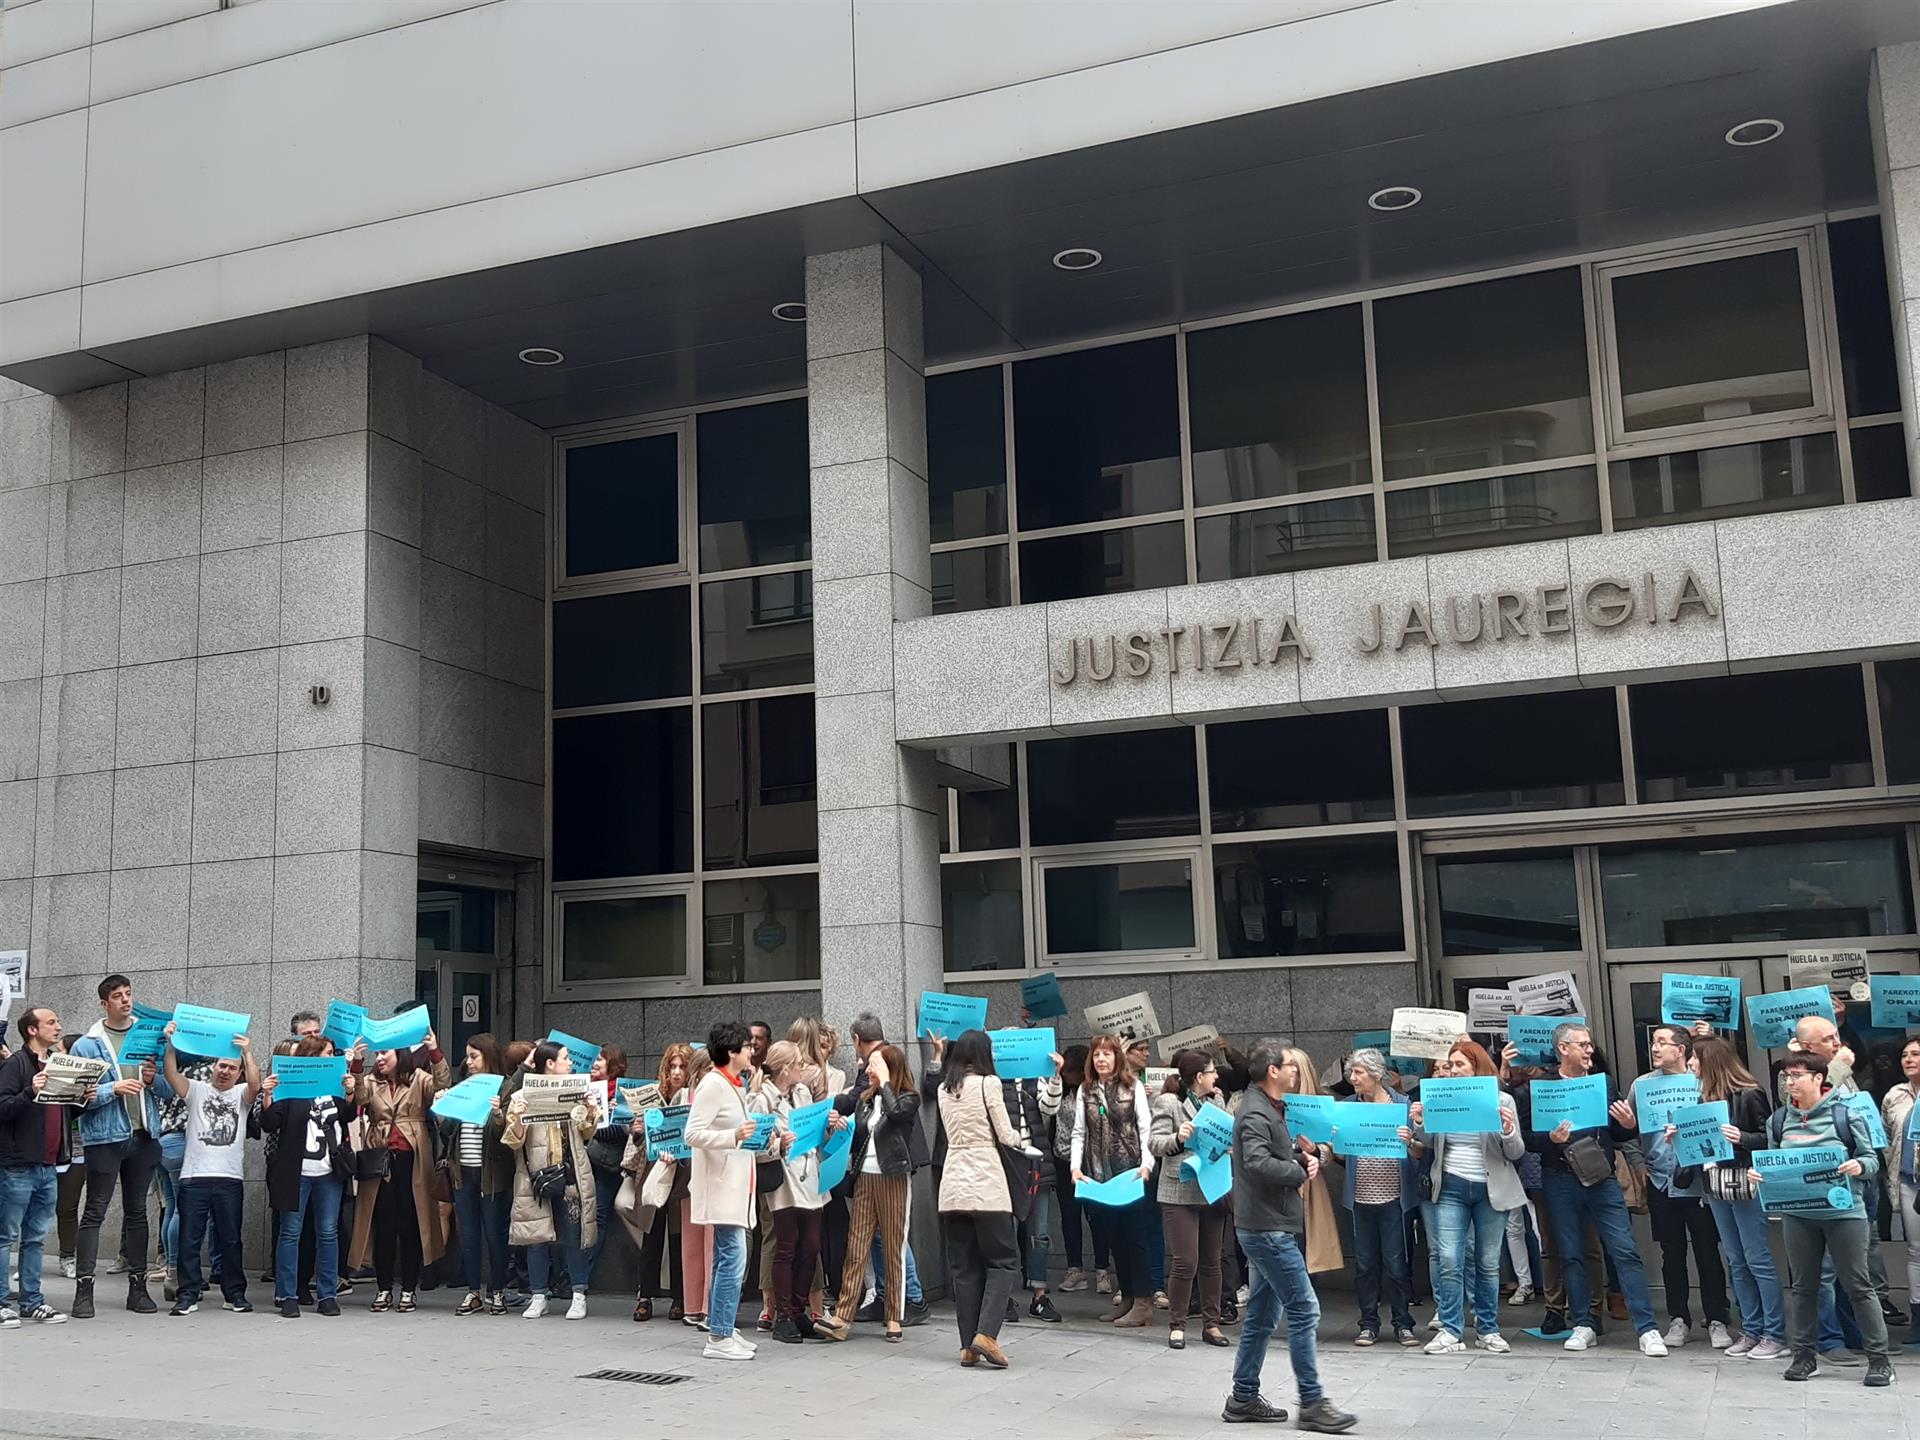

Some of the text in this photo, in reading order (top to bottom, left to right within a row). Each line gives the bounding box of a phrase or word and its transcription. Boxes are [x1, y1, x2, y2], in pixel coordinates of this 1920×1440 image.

[1053, 568, 1719, 685] JUSTIZIA JAUREGIA
[1791, 954, 1818, 964] HUELGA
[1832, 953, 1862, 962] JUSTICIA
[1519, 984, 1537, 992] HUELGA
[1671, 980, 1693, 989] HUELGA
[1704, 983, 1729, 991] JUSTICIA
[1097, 1004, 1143, 1021] PAREKOTASUNA
[1760, 1001, 1820, 1015] PAREKOTASUNA
[1102, 1017, 1132, 1029] ORAIN
[1766, 1013, 1804, 1024] ORAIN
[1168, 1035, 1211, 1051] PAREKOTASUNA
[52, 1056, 74, 1067] HUELGA
[83, 1063, 105, 1071] JUSTICIA
[525, 1079, 549, 1087] HUELGA
[561, 1079, 587, 1088] JUSTICIA
[1649, 1096, 1685, 1105] ORAIN
[1205, 1118, 1232, 1136] PAREKOT
[1682, 1129, 1708, 1138] ORAIN
[1755, 1152, 1837, 1167] HUELGA en JUSTICIA
